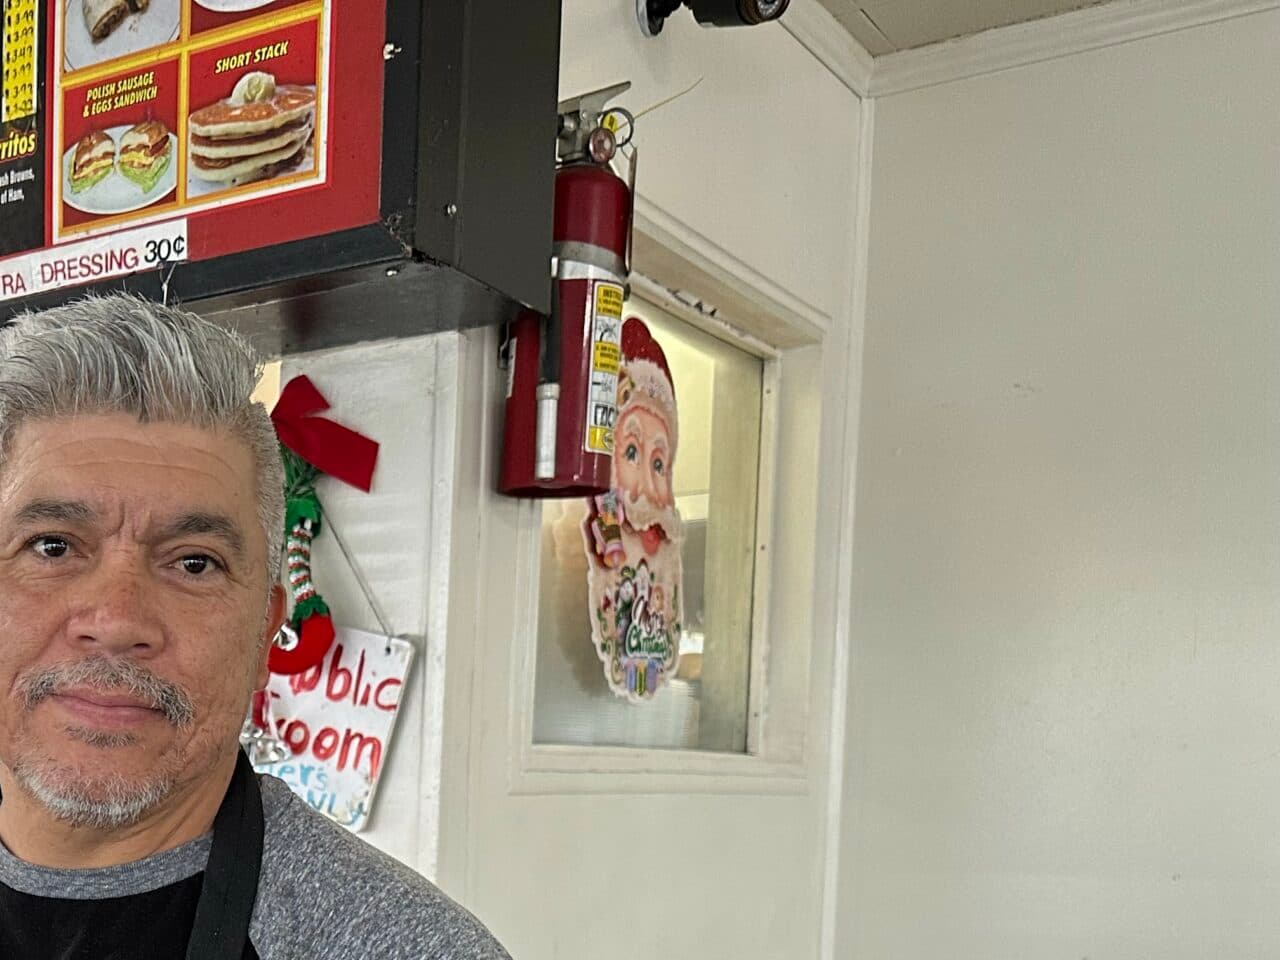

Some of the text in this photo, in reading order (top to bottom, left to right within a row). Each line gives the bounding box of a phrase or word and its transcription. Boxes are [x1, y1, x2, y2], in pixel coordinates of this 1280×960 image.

[215, 41, 289, 74] SHORT STACK
[83, 87, 157, 118] & EGGS SANDWICH
[87, 72, 154, 101] POLISH SAUSAGE
[41, 247, 139, 284] DRESSING
[144, 236, 185, 263] 30¢
[273, 643, 402, 711] ublic
